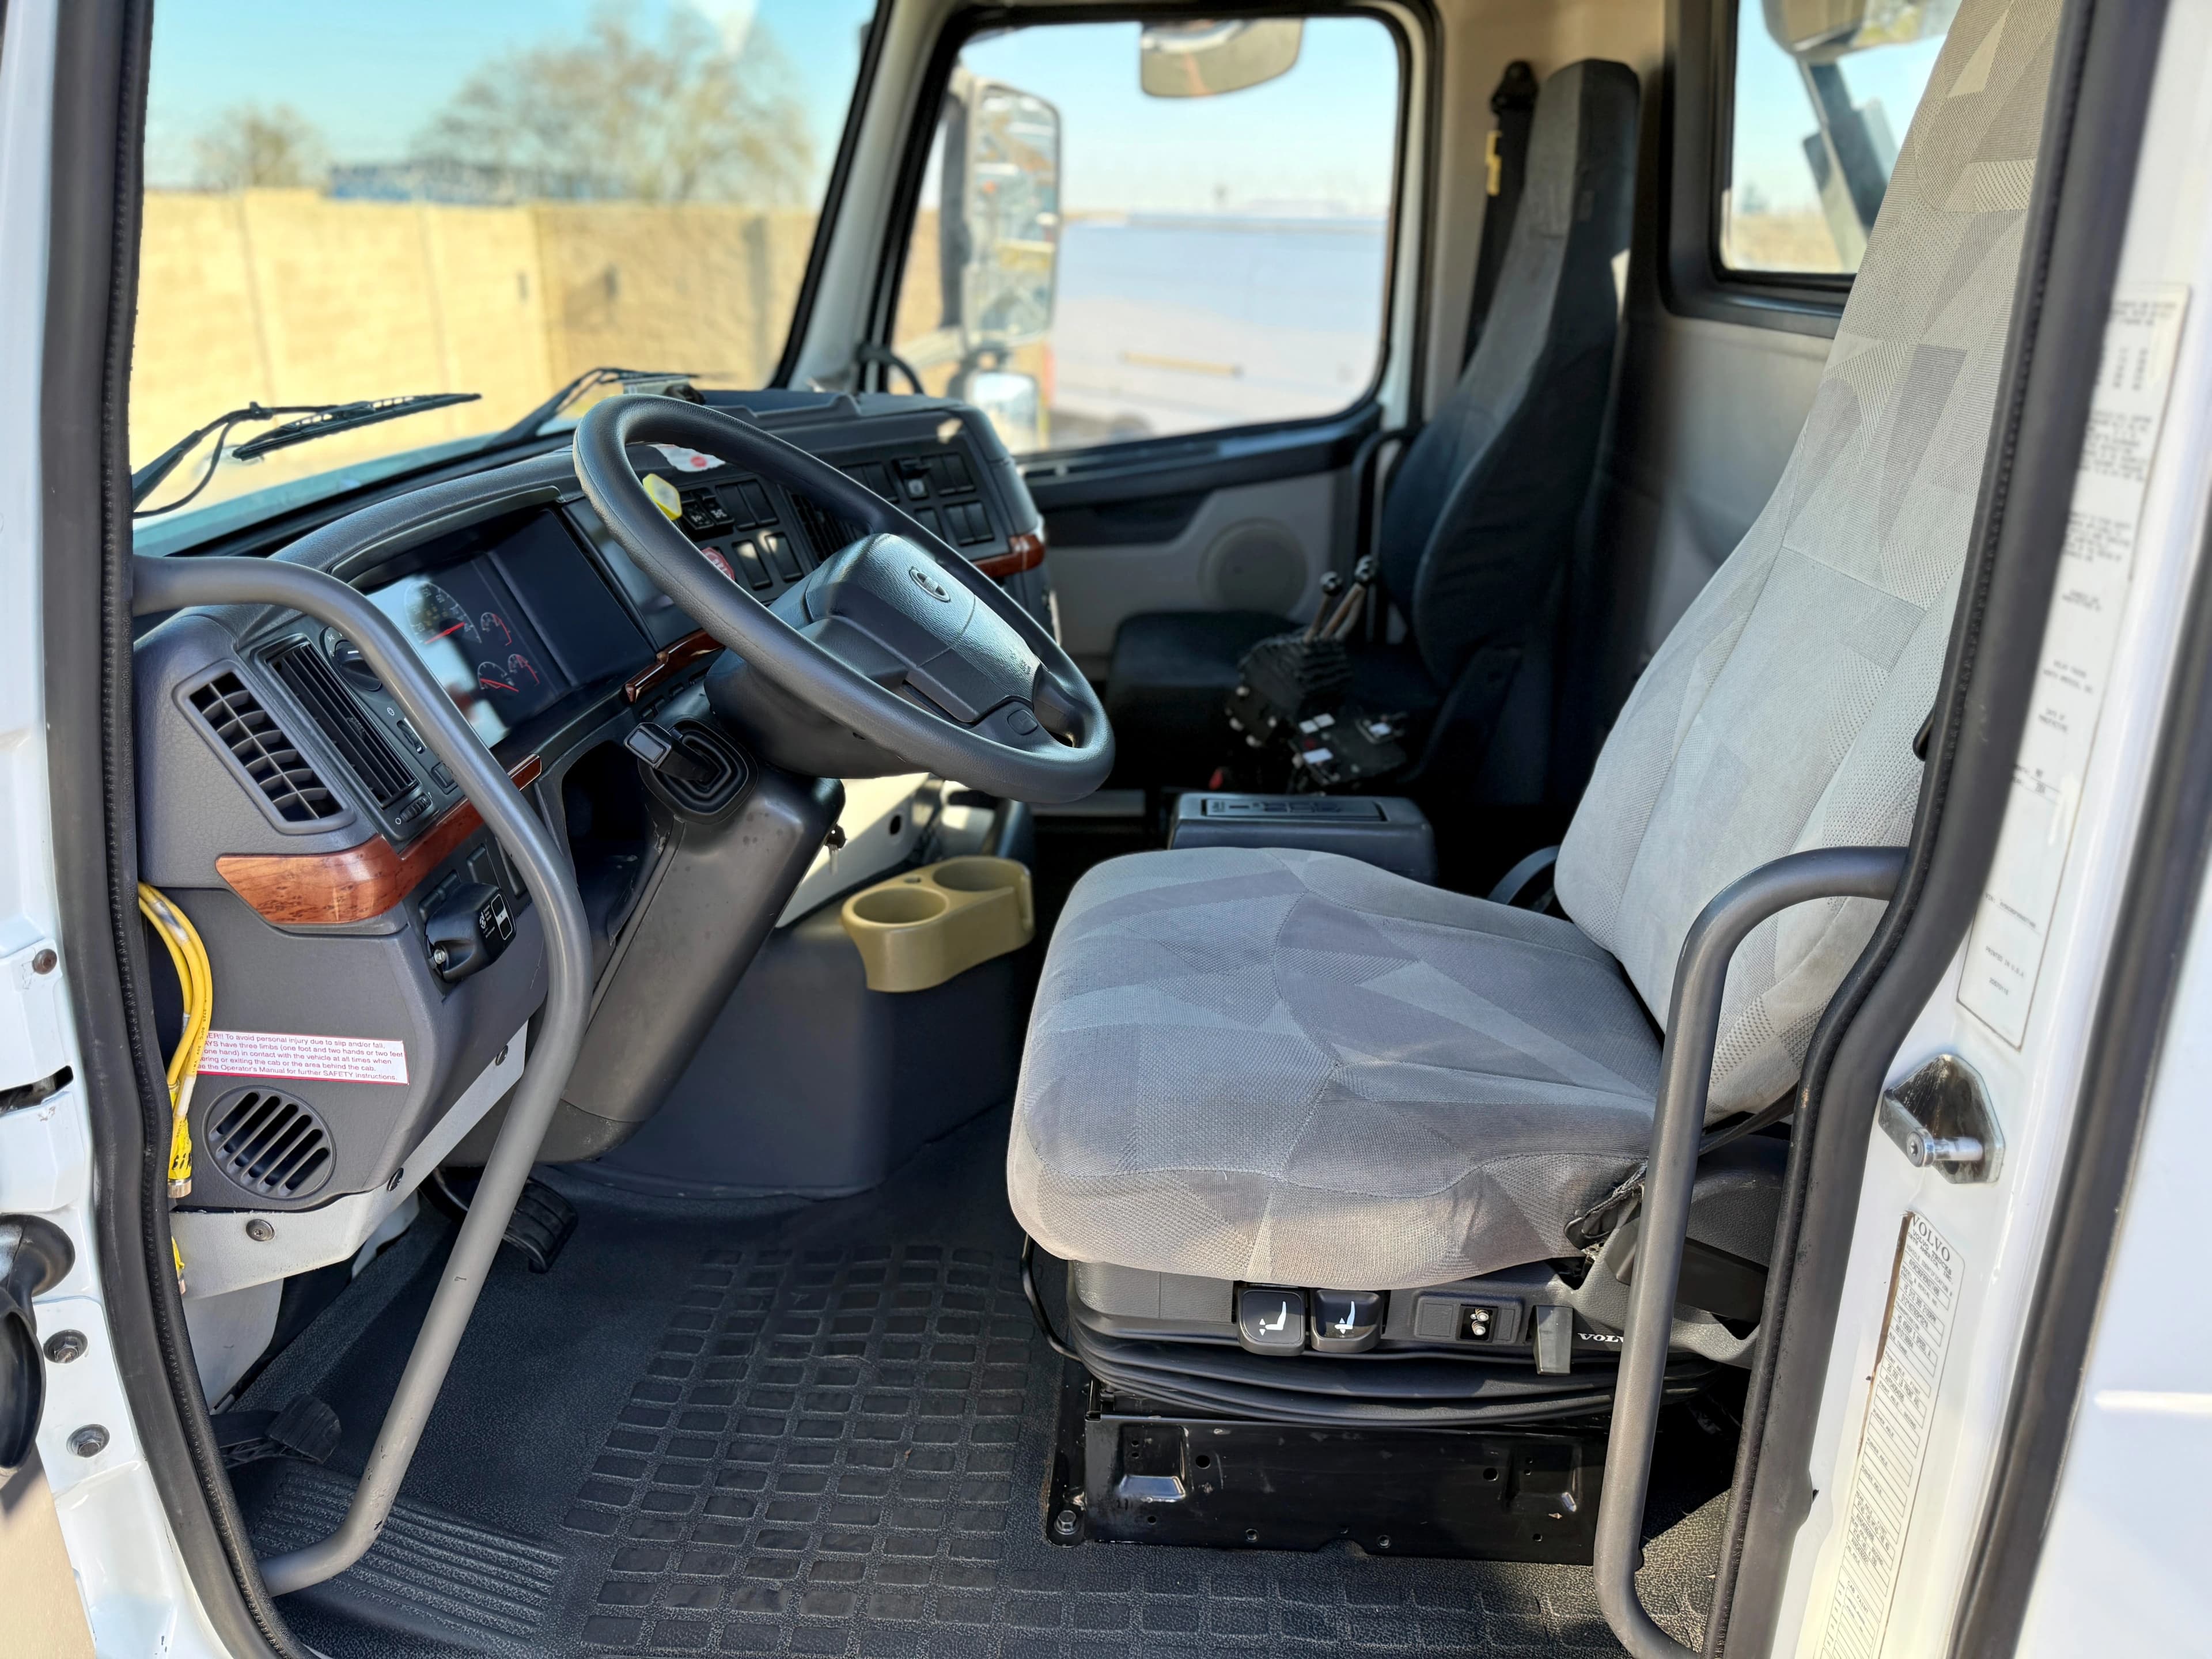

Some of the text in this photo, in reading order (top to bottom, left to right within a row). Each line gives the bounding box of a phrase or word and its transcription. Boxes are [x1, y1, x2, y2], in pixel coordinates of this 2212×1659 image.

[1986, 946, 2003, 962] PRINTED
[250, 1050, 275, 1058] contact
[289, 1037, 308, 1045] injury
[221, 1065, 257, 1073] Operator's
[1912, 1214, 1950, 1262] VOLVO
[1913, 1229, 1952, 1275] VOLVO TRUCKS
[1907, 1232, 1953, 1284] ORTH AMERICA, INC.
[1907, 1244, 1920, 1260] VEHICLE
[1922, 1260, 1948, 1292] IDENTIFICATION
[1901, 1270, 1913, 1285] ENGINE
[1902, 1265, 1912, 1278] MODEL
[1918, 1282, 1930, 1298] SERIAL
[1896, 1301, 1919, 1331] TRANSMISSION
[1885, 1350, 1895, 1365] FRONT
[1896, 1365, 1904, 1376] AXLE
[1910, 1381, 1921, 1396] FIRST
[1879, 1380, 1889, 1395] FRONT
[1891, 1395, 1899, 1407] AXLE
[1903, 1411, 1916, 1429] SECOND
[1904, 1384, 1913, 1398] FRONT
[1873, 1408, 1894, 1437] PUSHER AXLE
[1867, 1437, 1888, 1467] PUSHER AXLE
[1861, 1464, 1873, 1482] PUSHER
[1857, 1594, 1868, 1614] PAINT
